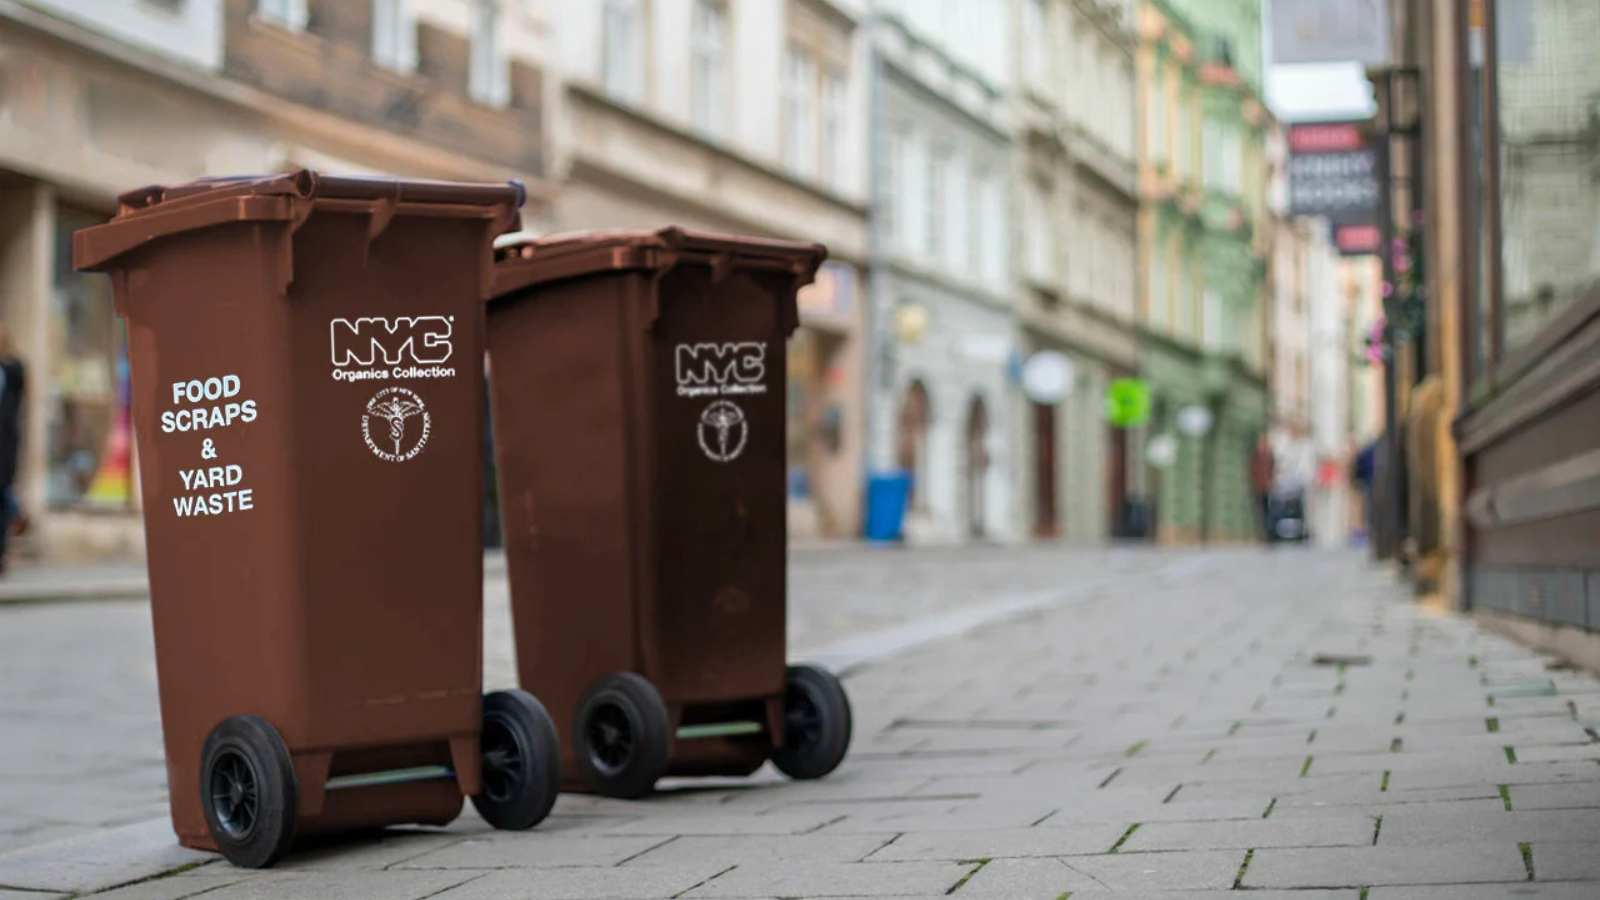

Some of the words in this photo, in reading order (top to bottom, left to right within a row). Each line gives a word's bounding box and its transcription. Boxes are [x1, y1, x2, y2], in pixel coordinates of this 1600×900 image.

[330, 316, 452, 366] NYC
[332, 368, 389, 382] Organics
[392, 366, 455, 378] Collection
[676, 342, 765, 384] NYC
[172, 374, 240, 404] FOOD
[161, 400, 257, 432] SCRAPS
[201, 438, 218, 460] &
[361, 415, 395, 462] DEPARTMENT
[406, 412, 430, 459] SANITATION
[179, 464, 243, 490] YARD
[173, 489, 253, 516] WASTE
